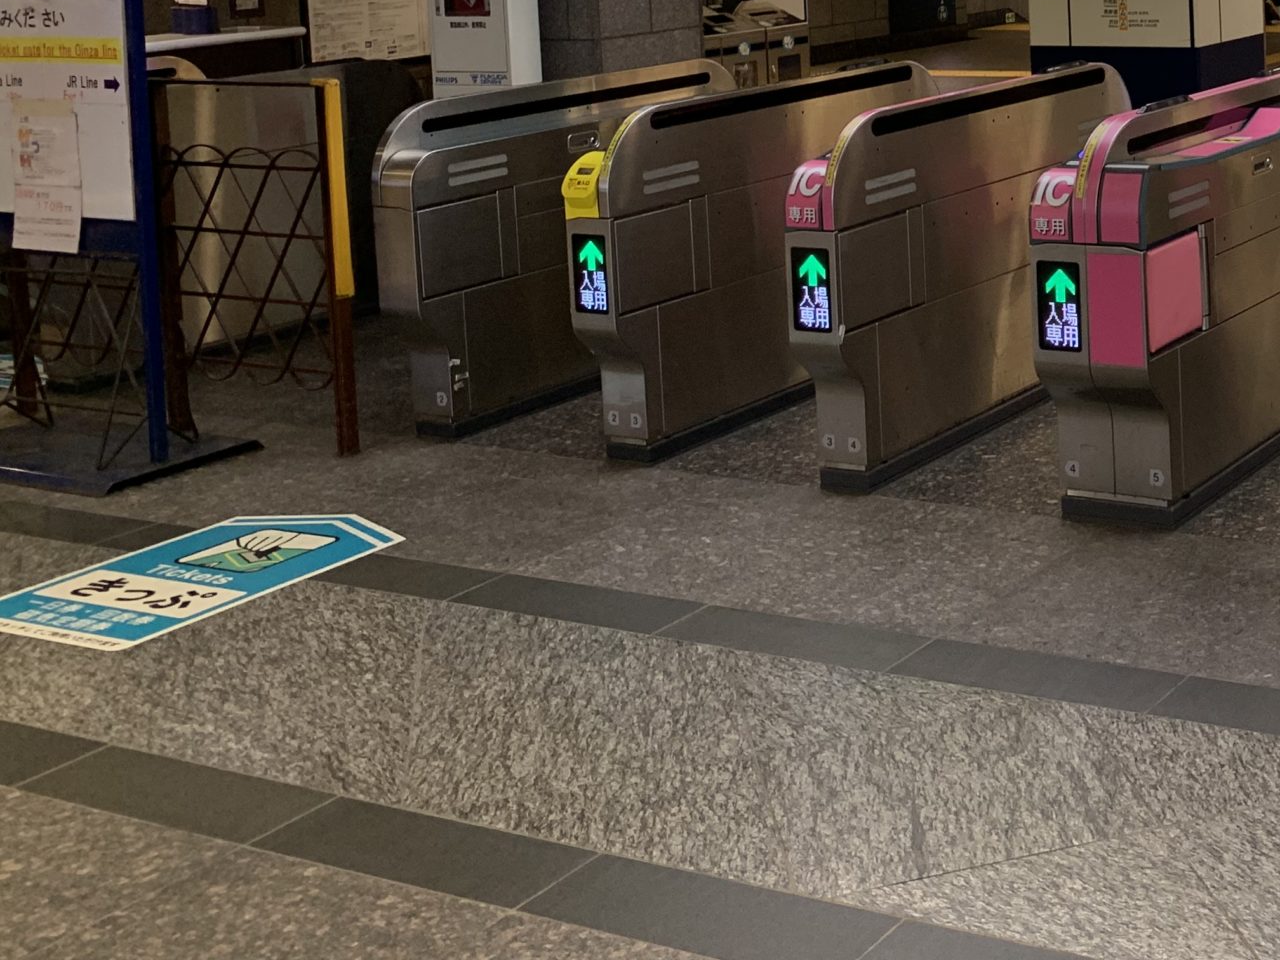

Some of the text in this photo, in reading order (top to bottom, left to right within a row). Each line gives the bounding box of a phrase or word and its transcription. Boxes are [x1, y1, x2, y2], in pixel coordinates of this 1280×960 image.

[6, 74, 22, 87] Line
[67, 75, 98, 89] JR Line
[789, 166, 827, 196] IC
[1031, 174, 1075, 206] IC
[788, 207, 816, 223] 専用
[1035, 218, 1065, 235] 専用
[580, 271, 606, 291] 入場
[580, 290, 607, 310] 専用
[800, 286, 828, 308] 入場
[800, 307, 829, 329] 専用
[1046, 302, 1077, 326] 入場
[1046, 324, 1078, 347] 専用
[610, 413, 617, 423] 2
[632, 415, 638, 425] 3
[826, 437, 833, 447] 3
[850, 440, 857, 450] 4
[1069, 463, 1076, 474] 4
[1153, 472, 1160, 483] 5
[147, 564, 234, 586] Tickets
[70, 576, 218, 610] きっぷ
